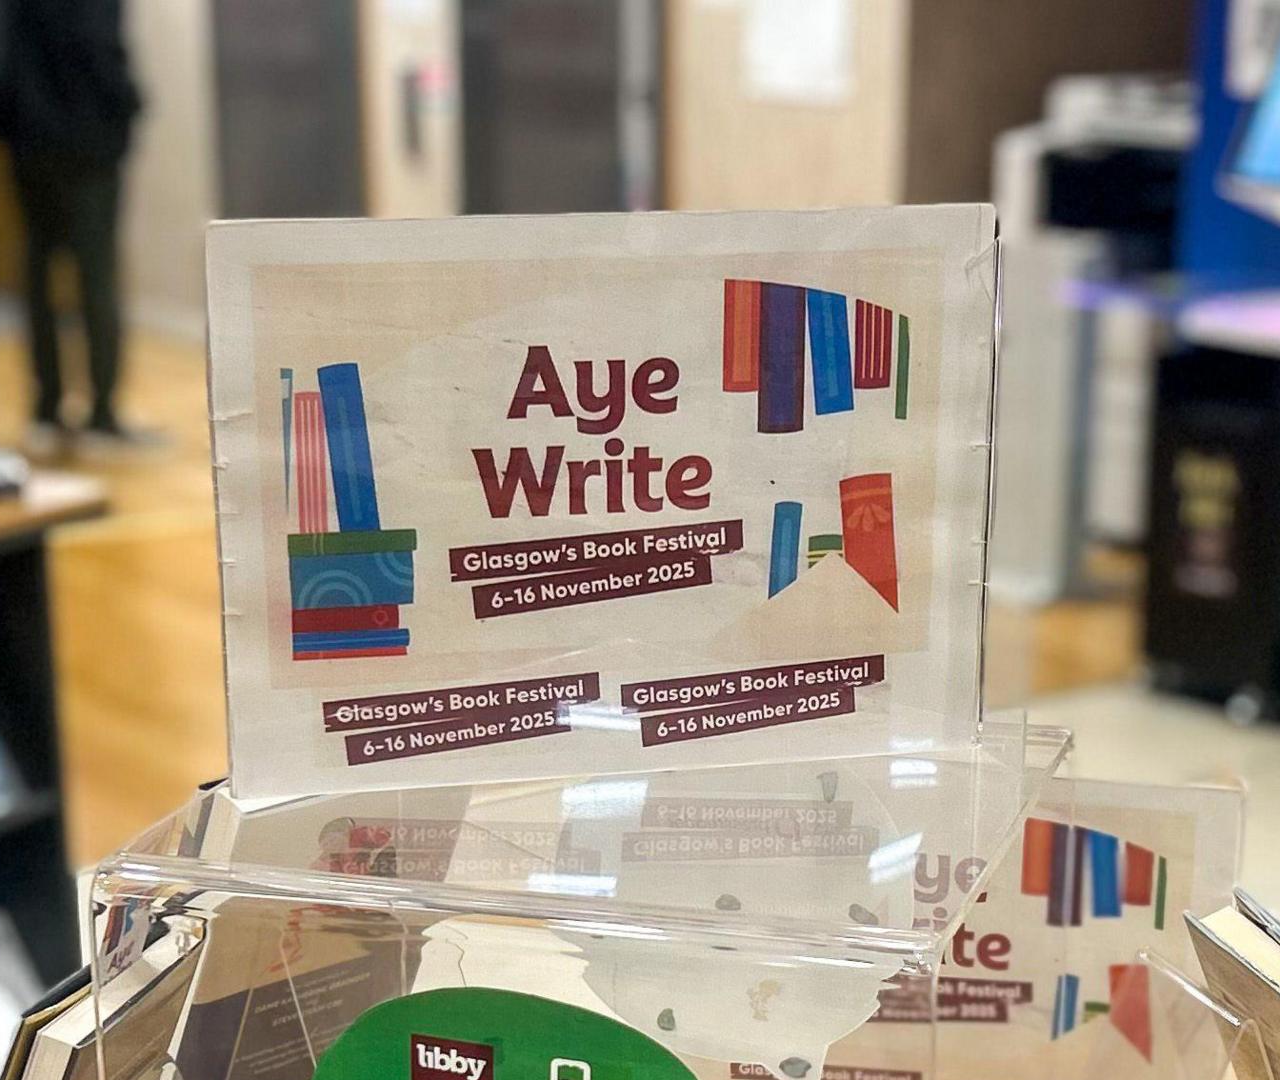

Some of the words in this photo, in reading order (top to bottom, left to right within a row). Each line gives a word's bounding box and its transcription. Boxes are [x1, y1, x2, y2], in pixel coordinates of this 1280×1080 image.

[507, 345, 680, 435] Aye
[471, 438, 713, 518] Write
[463, 543, 577, 572] Glasgow's
[583, 536, 637, 560] Book
[643, 527, 726, 552] Festival
[491, 586, 536, 609] 6-16
[541, 571, 642, 601] November
[648, 561, 695, 584] 2025
[336, 696, 444, 722] Glasgow's
[449, 691, 501, 711] Book
[506, 680, 584, 703] Festival
[633, 680, 736, 705] Glasgow's
[740, 675, 789, 693] Book
[794, 662, 869, 686] Festival
[363, 735, 405, 756] 6-16
[410, 722, 505, 749] November
[510, 711, 555, 732] 2025
[657, 717, 697, 737] 6-16
[702, 705, 793, 730] November
[797, 692, 840, 713] 2025
[914, 852, 987, 904] ye
